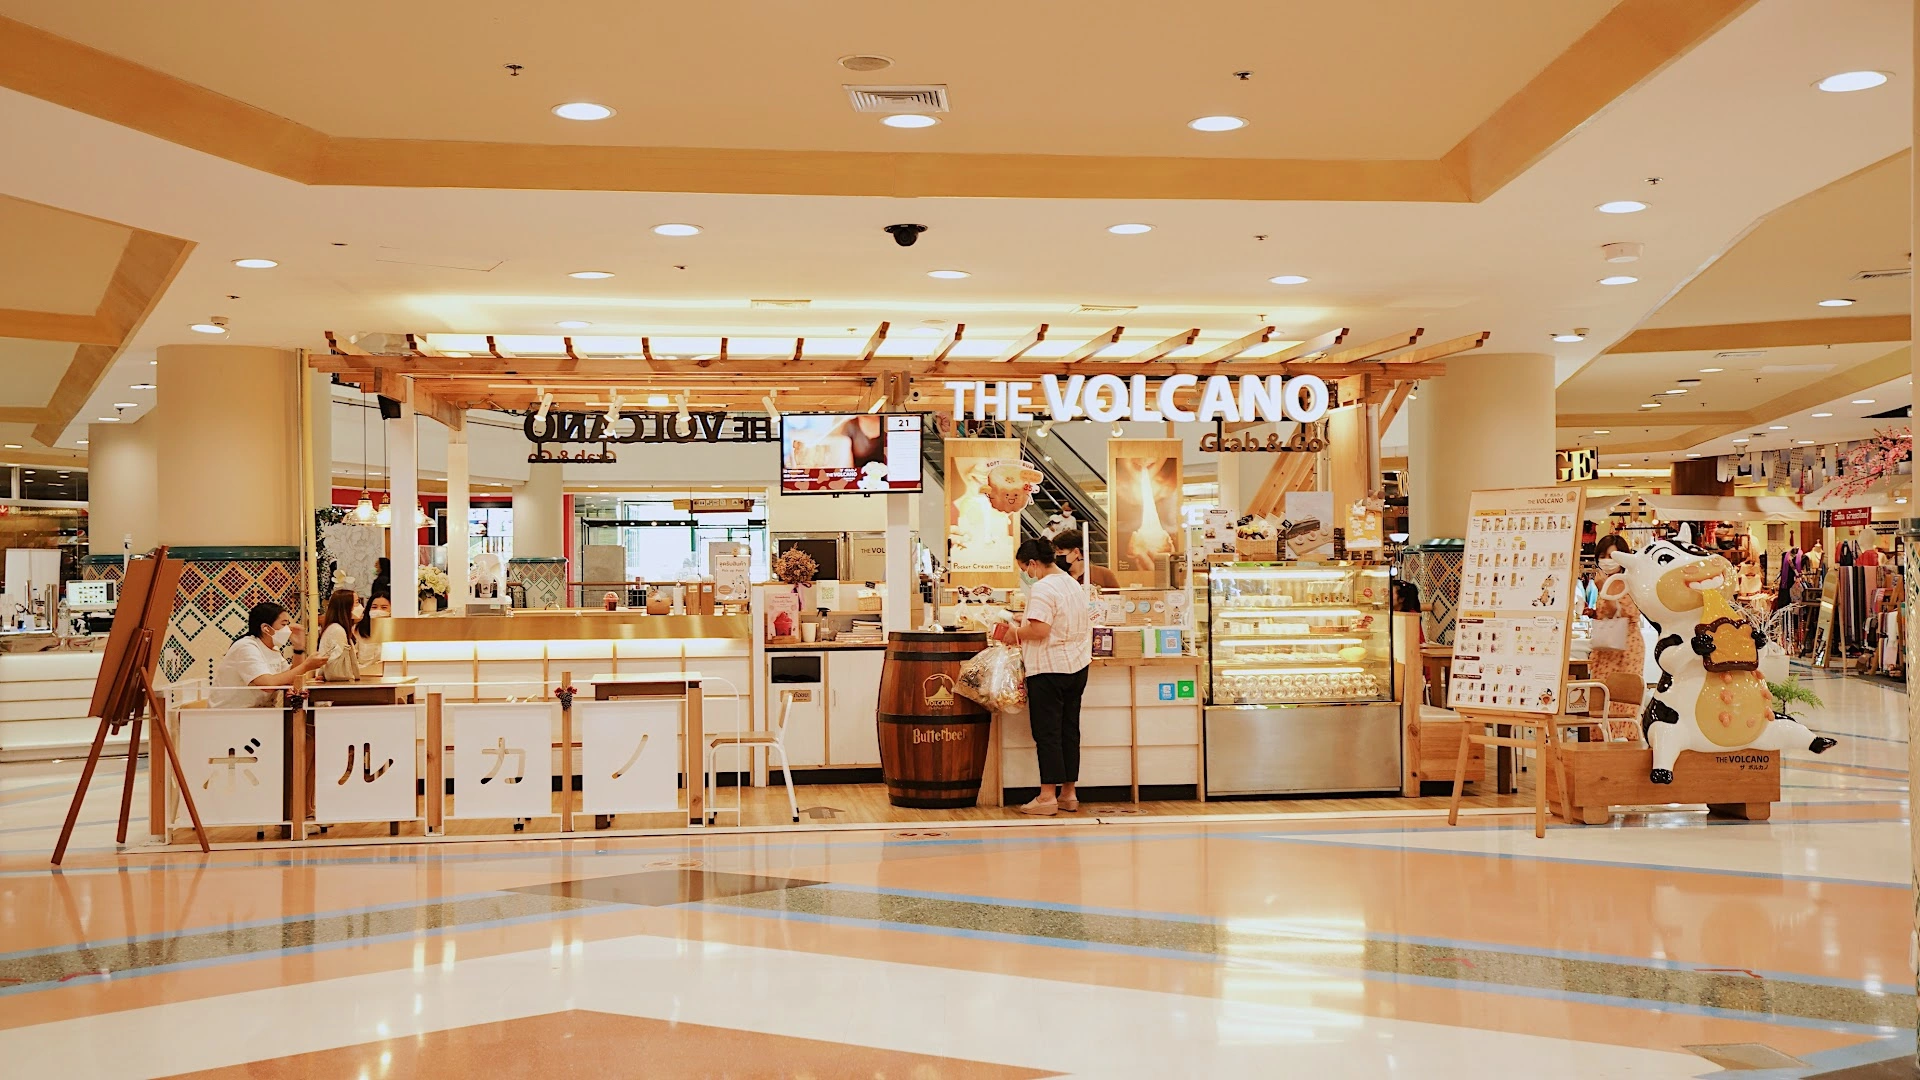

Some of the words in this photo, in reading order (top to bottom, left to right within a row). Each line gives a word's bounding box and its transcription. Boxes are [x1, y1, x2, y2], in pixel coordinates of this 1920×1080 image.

[944, 380, 1034, 421] THE
[1040, 373, 1330, 423] VOLCANO
[1200, 432, 1260, 453] Grab
[1266, 432, 1284, 453] &
[1290, 432, 1324, 453] Go
[973, 562, 993, 570] Cream
[912, 727, 968, 745] Butterbeer
[1728, 755, 1770, 763] VOLCANO
